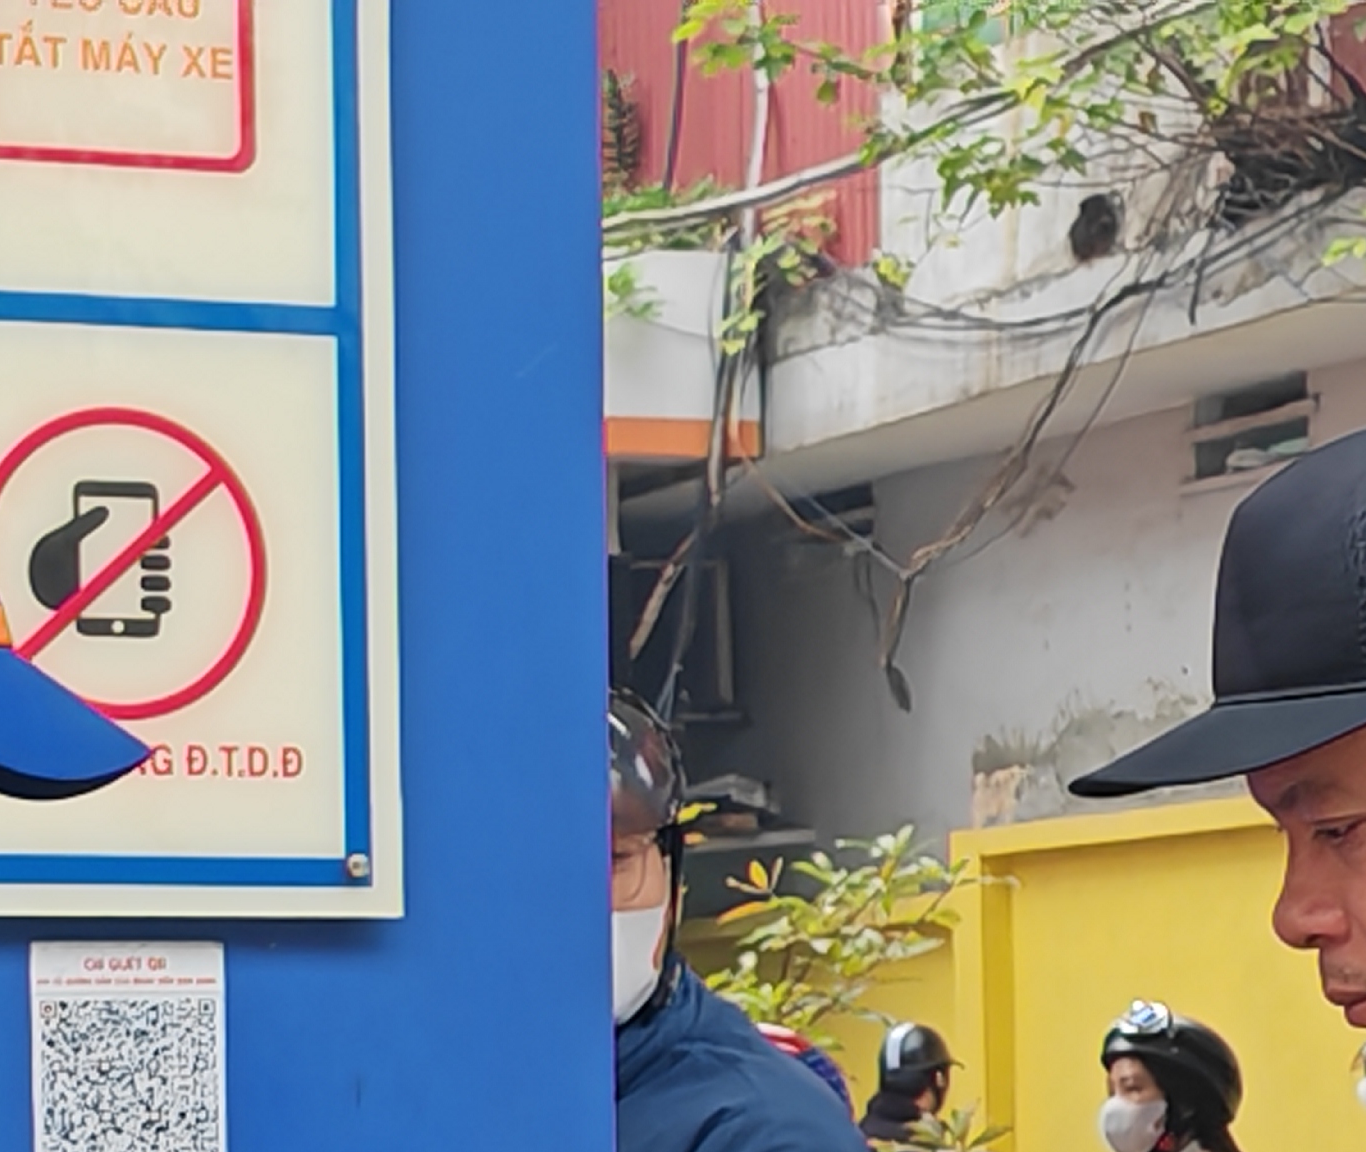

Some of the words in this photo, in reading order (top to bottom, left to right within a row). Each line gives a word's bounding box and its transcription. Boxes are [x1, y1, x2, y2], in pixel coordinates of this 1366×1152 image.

[81, 31, 167, 75] MÁY
[181, 45, 233, 79] XE
[186, 744, 303, 778] Đ.T.D.Đ
